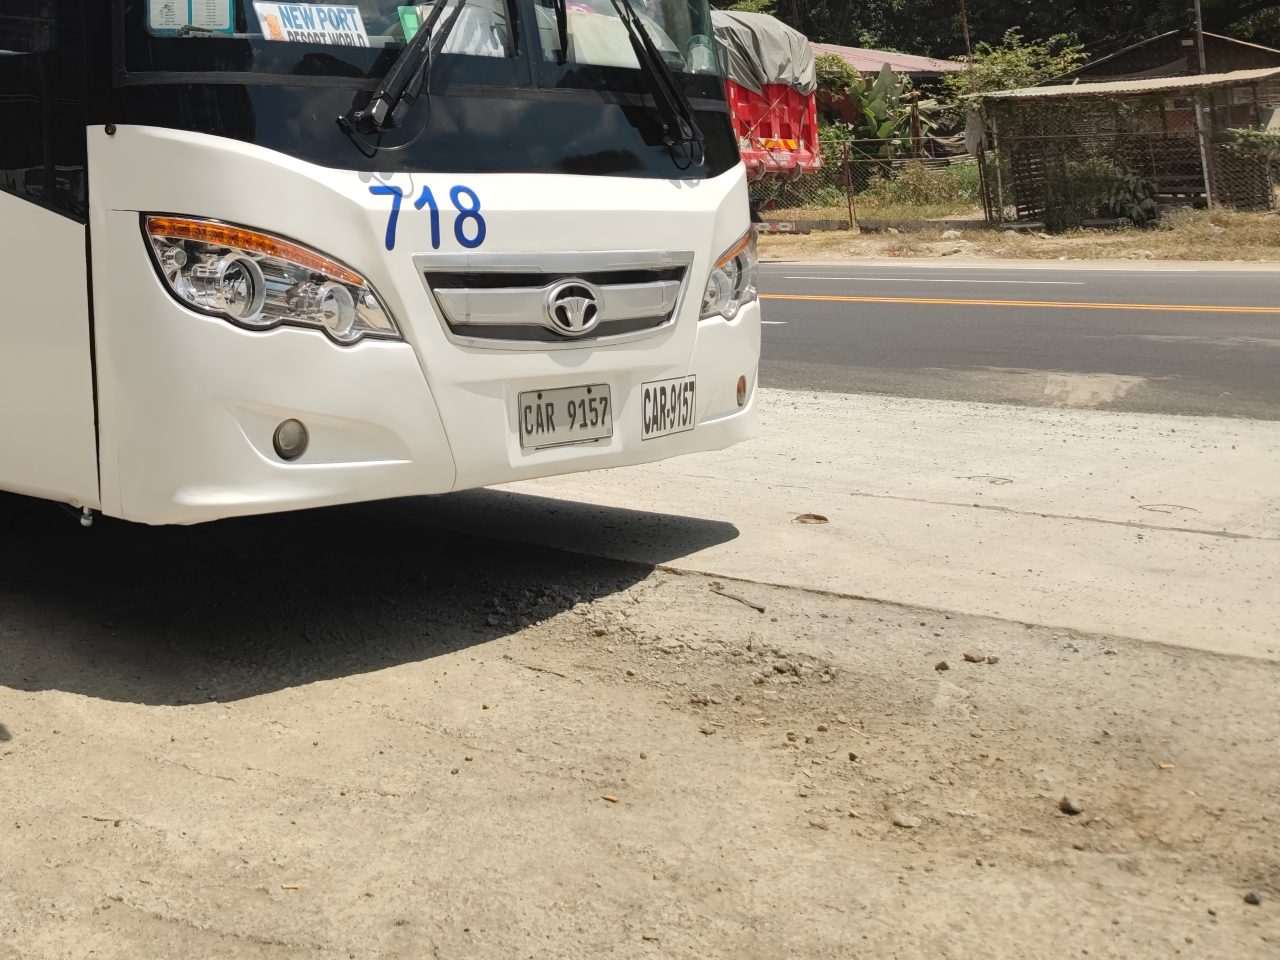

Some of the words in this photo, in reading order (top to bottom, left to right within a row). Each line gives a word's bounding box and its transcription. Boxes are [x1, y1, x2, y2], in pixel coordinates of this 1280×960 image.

[277, 5, 316, 30] NEW
[316, 7, 359, 31] PORT
[368, 184, 487, 252] 718
[524, 402, 556, 435] CAR
[567, 396, 608, 430] 9157
[643, 380, 695, 435] CAR-9157
